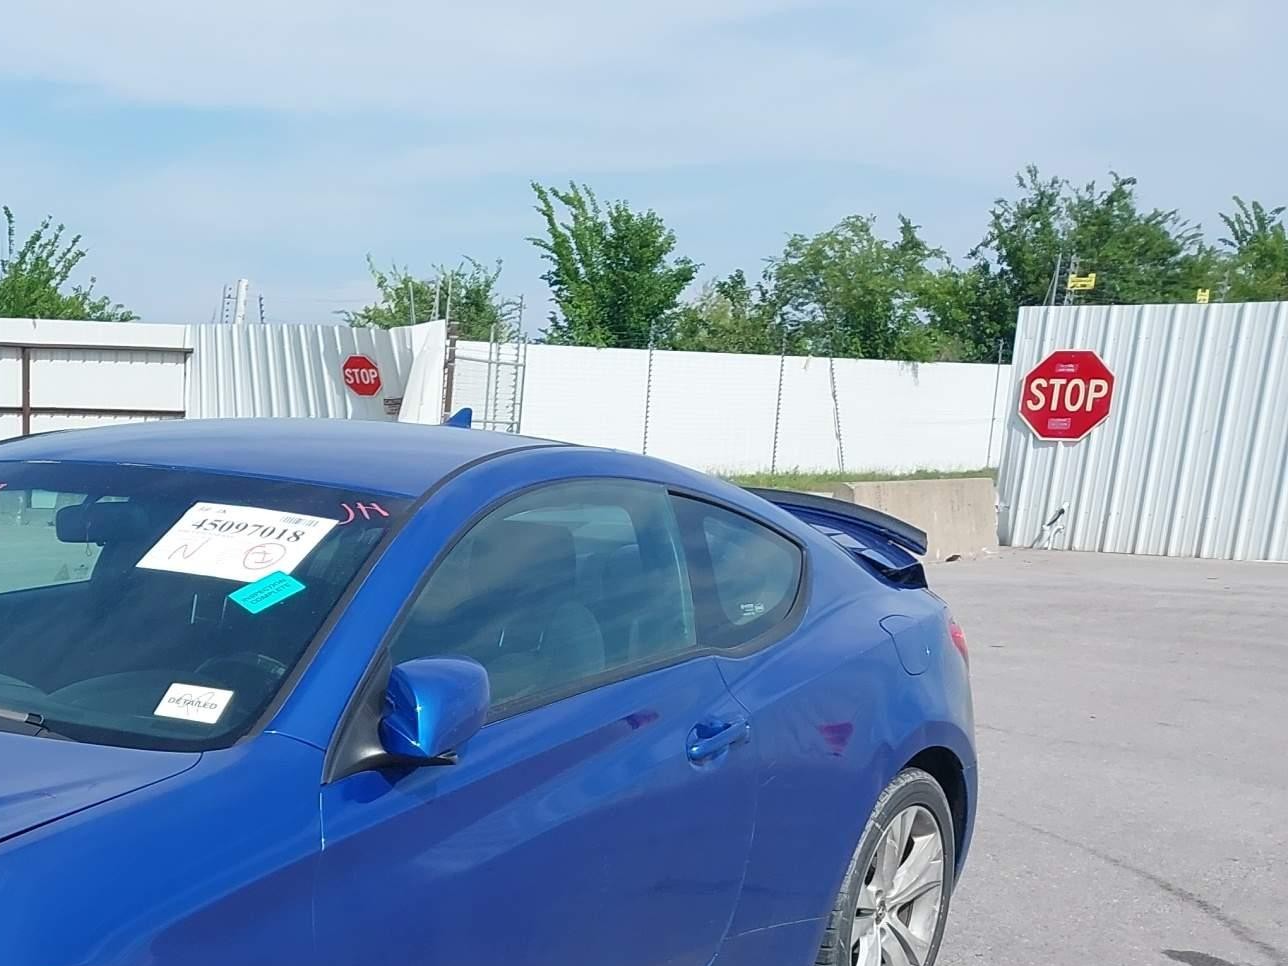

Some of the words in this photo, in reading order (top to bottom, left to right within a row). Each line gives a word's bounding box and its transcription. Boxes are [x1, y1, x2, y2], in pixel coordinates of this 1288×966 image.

[344, 368, 378, 385] STOP
[1026, 378, 1109, 412] STOP
[191, 517, 306, 543] 45097018
[167, 697, 218, 710] DETAILED
